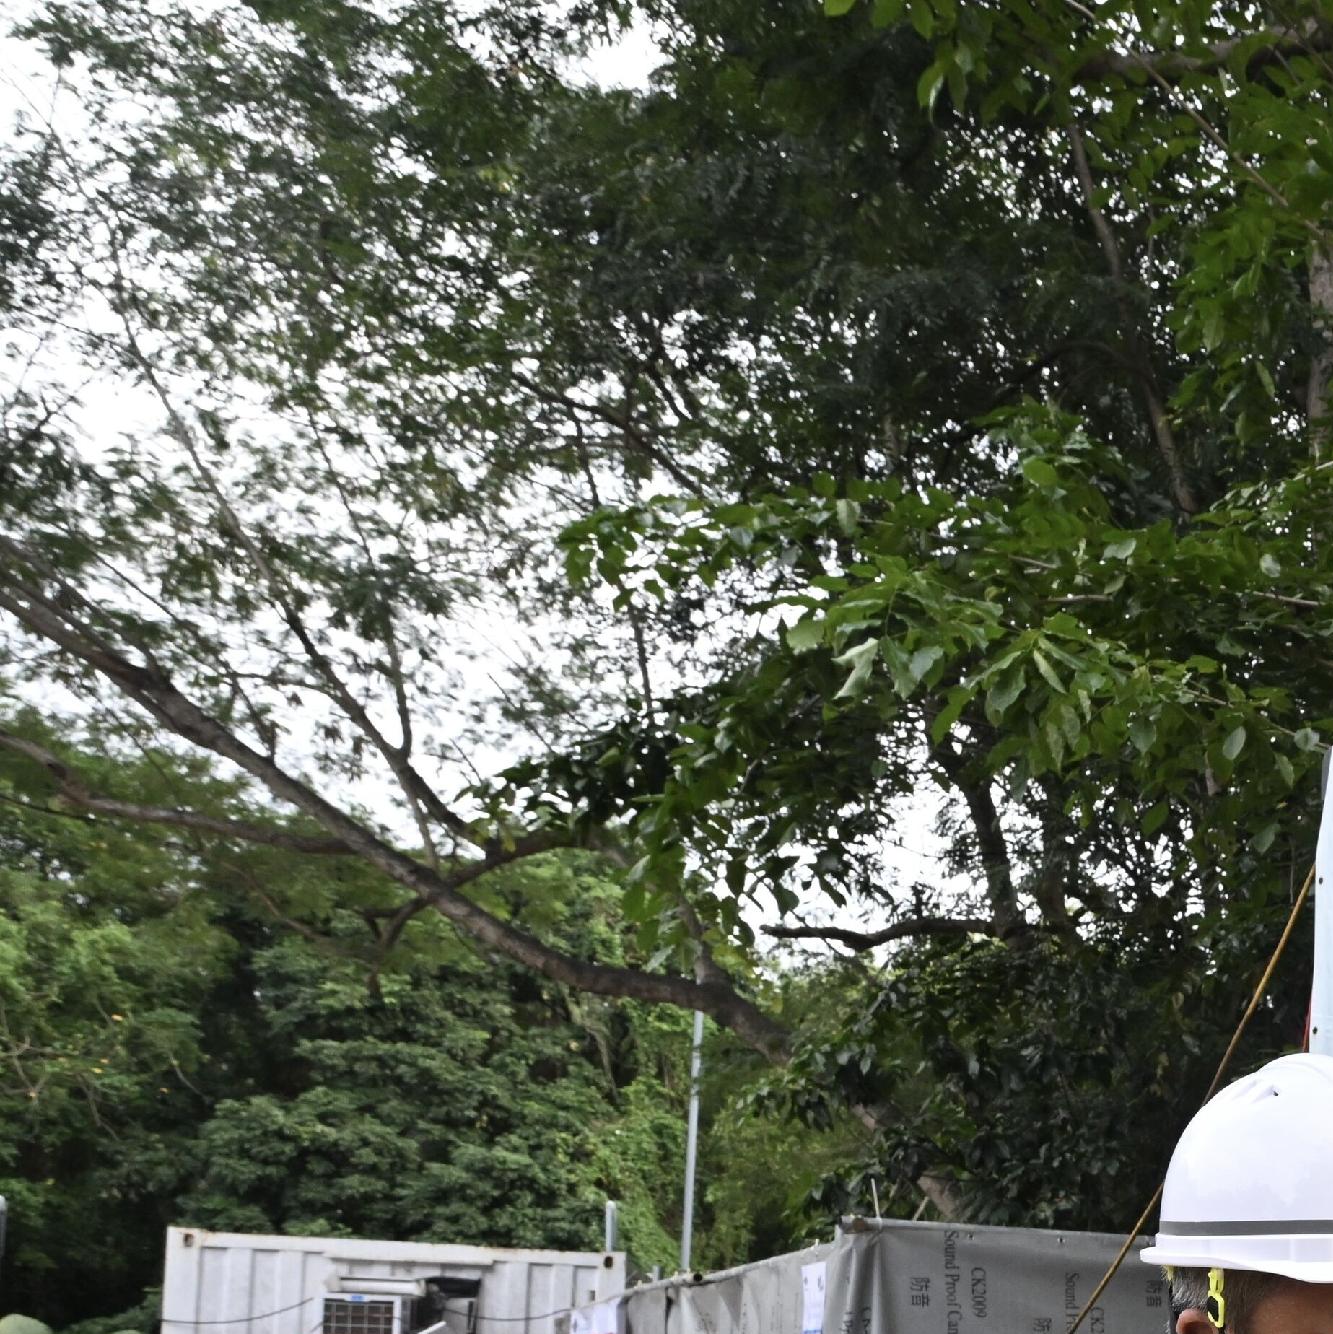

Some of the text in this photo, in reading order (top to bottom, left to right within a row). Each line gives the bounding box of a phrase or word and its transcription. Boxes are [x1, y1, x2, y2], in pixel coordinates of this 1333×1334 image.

[944, 1230, 959, 1269] Sound
[910, 1277, 931, 1308] 防音
[945, 1274, 961, 1308] Proof
[971, 1266, 988, 1319] CK2009
[1064, 1272, 1080, 1309] Sound
